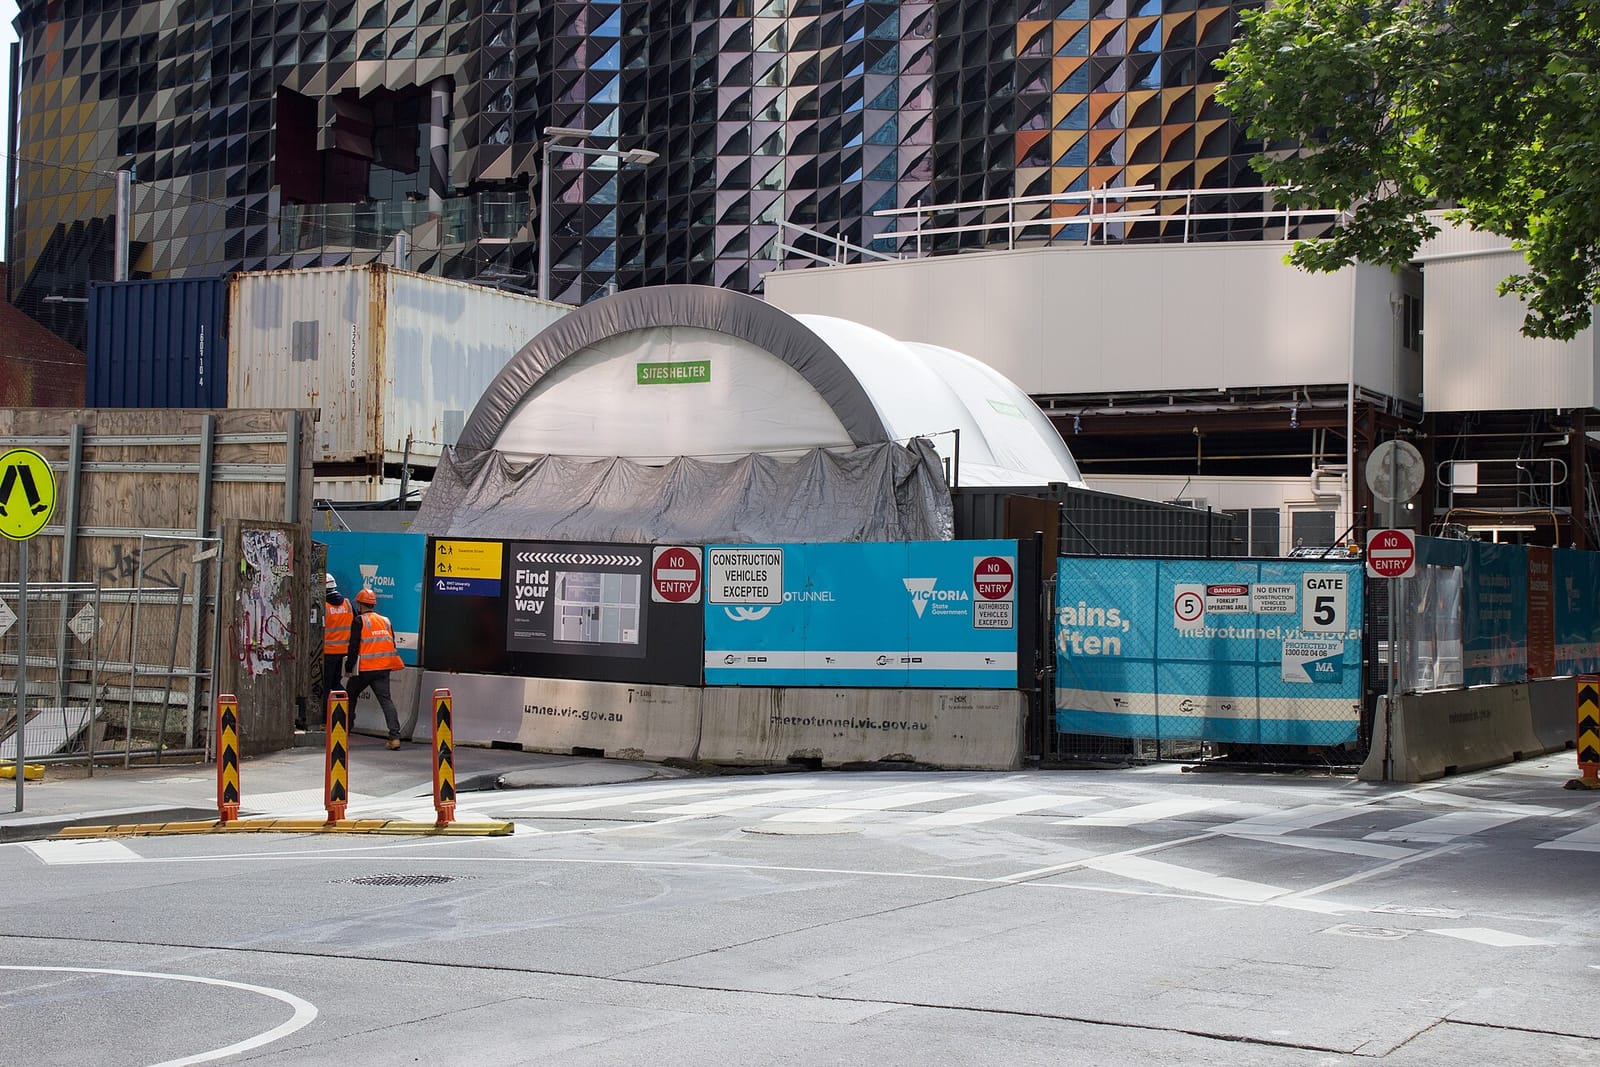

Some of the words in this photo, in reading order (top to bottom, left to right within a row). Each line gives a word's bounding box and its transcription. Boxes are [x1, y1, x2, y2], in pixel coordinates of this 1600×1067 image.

[643, 366, 705, 379] SITESHELTER
[1384, 538, 1398, 547] NO
[670, 557, 685, 568] NO
[712, 554, 780, 566] CONSTRUCTION
[1375, 560, 1407, 569] ENTRY
[987, 564, 1000, 573] NO
[516, 570, 549, 585] Find
[725, 570, 768, 582] VEHICLES
[660, 582, 693, 593] ENTRY
[979, 584, 1008, 593] ENTRY
[1307, 579, 1343, 590] GATE
[515, 585, 549, 599] your
[723, 586, 769, 598] EXCEPTED
[911, 591, 969, 601] VICTORIA
[515, 600, 545, 614] way
[1184, 599, 1194, 614] 5
[1313, 596, 1336, 626] 5
[1055, 629, 1121, 655] ften
[1285, 642, 1327, 650] PROTECTED
[1315, 663, 1335, 672] MA
